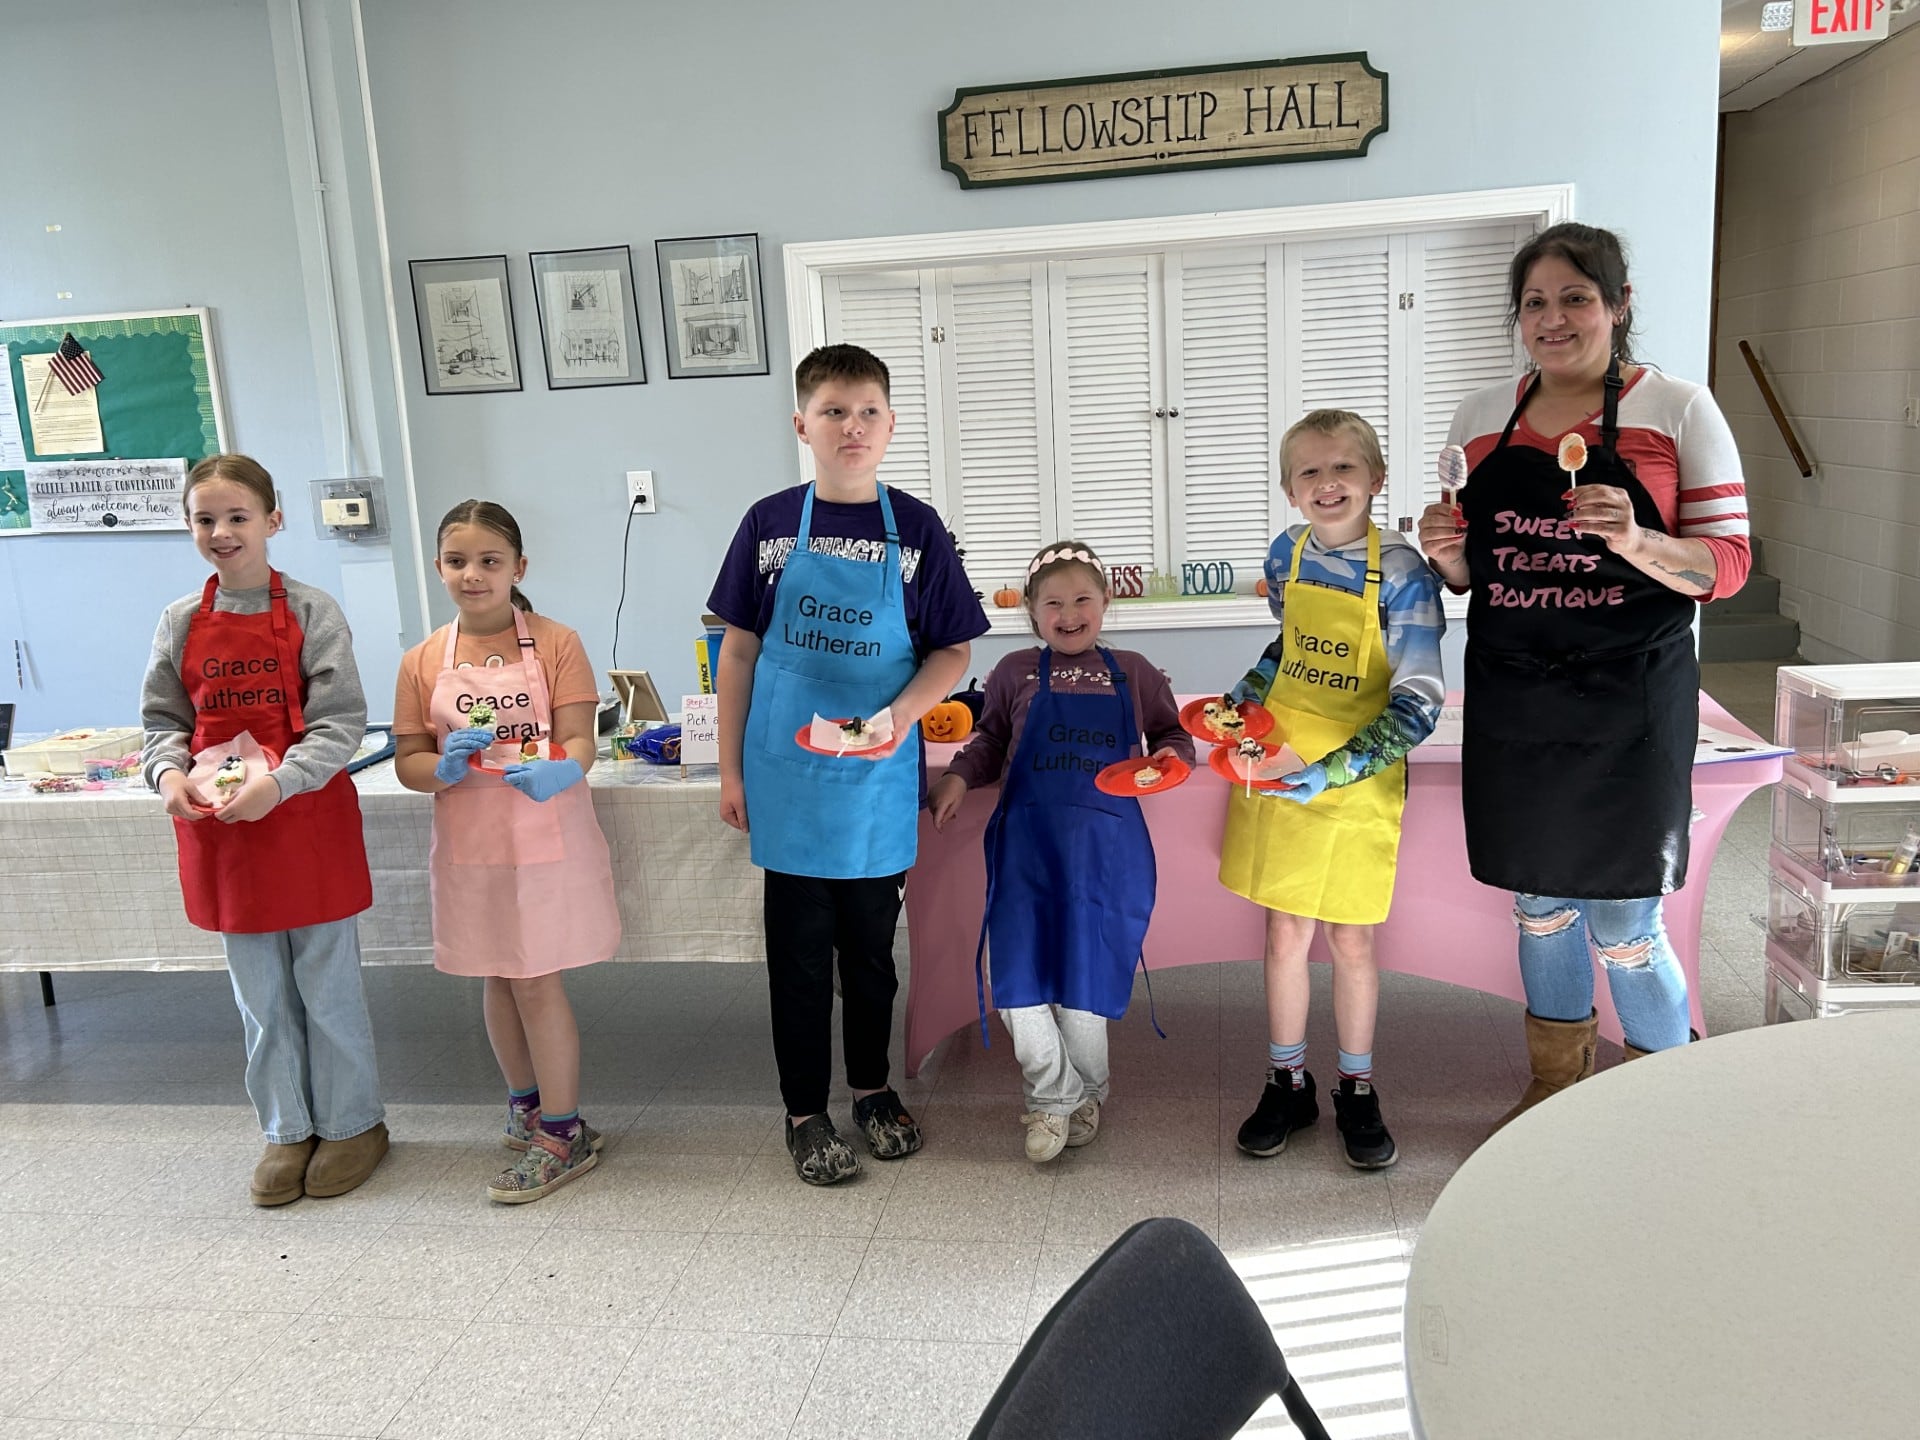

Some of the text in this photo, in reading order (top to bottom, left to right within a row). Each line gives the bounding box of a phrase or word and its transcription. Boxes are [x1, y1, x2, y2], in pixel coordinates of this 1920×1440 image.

[962, 80, 1360, 160] FELLOWSHIP HALL
[115, 478, 176, 492] CONVERSATION
[47, 500, 84, 522] always
[90, 495, 142, 513] welcome
[1494, 510, 1583, 540] SWEE
[1104, 566, 1144, 598] ESS
[1182, 561, 1235, 596] FOOD
[1488, 583, 1625, 608] BOUTIQUE
[798, 595, 873, 626] Grace
[784, 623, 881, 657] Lutheran
[203, 658, 278, 679] Grace
[201, 688, 287, 710] uthera
[686, 712, 707, 726] Pick
[1050, 724, 1116, 749] Grace
[1033, 752, 1112, 773] Luther
